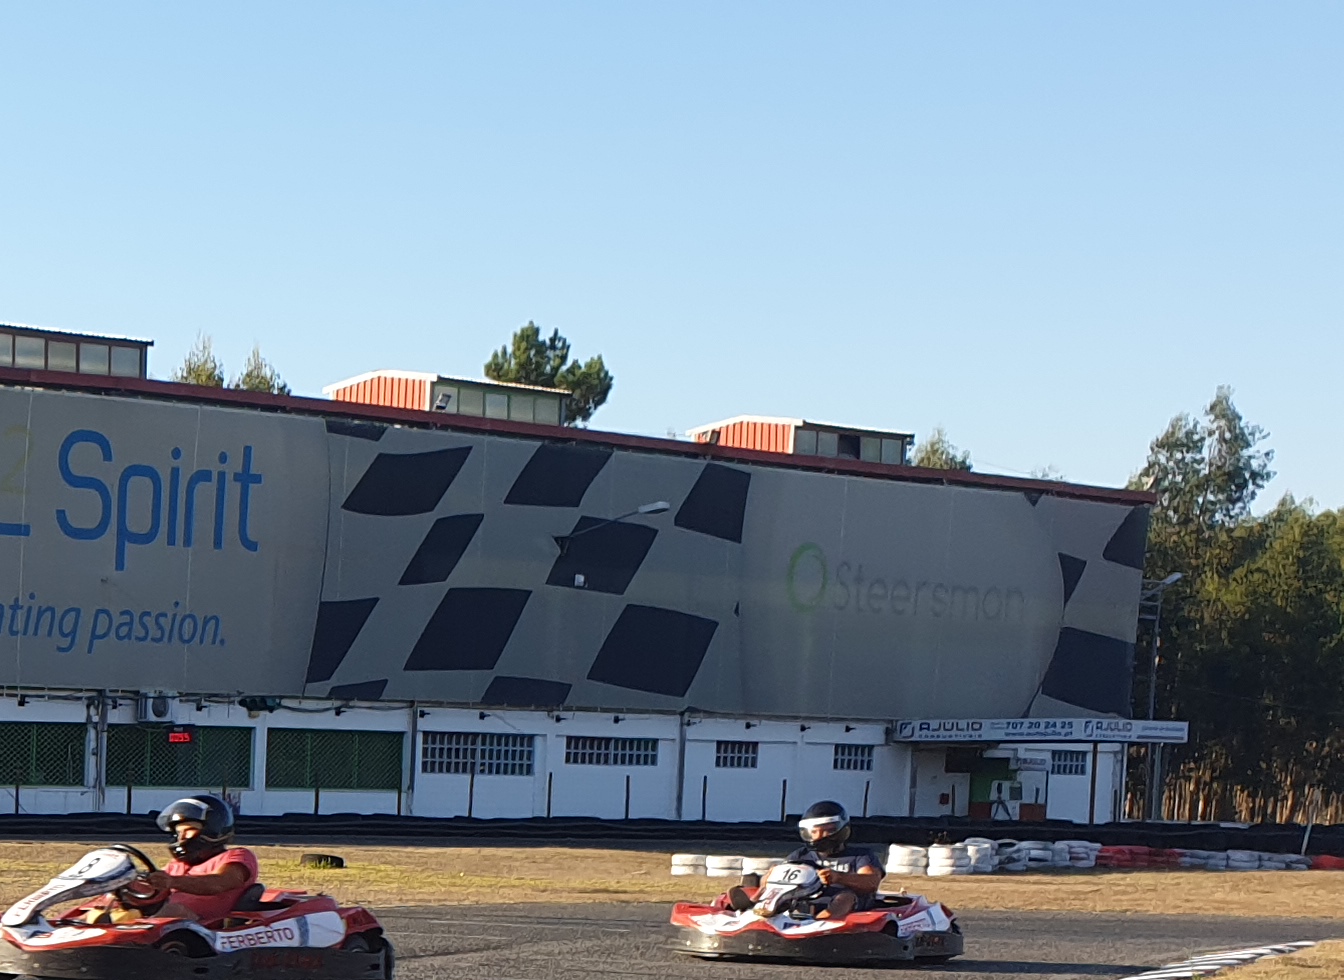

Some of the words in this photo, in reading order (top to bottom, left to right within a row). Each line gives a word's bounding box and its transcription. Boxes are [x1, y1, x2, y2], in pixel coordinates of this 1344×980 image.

[55, 429, 264, 573] Spirit
[86, 600, 227, 654] passion.
[1005, 721, 1024, 730] 707
[1027, 721, 1041, 730] 20
[1044, 721, 1057, 730] 24
[77, 857, 101, 875] 8
[782, 867, 802, 882] 16
[219, 926, 295, 949] FERBERTO
